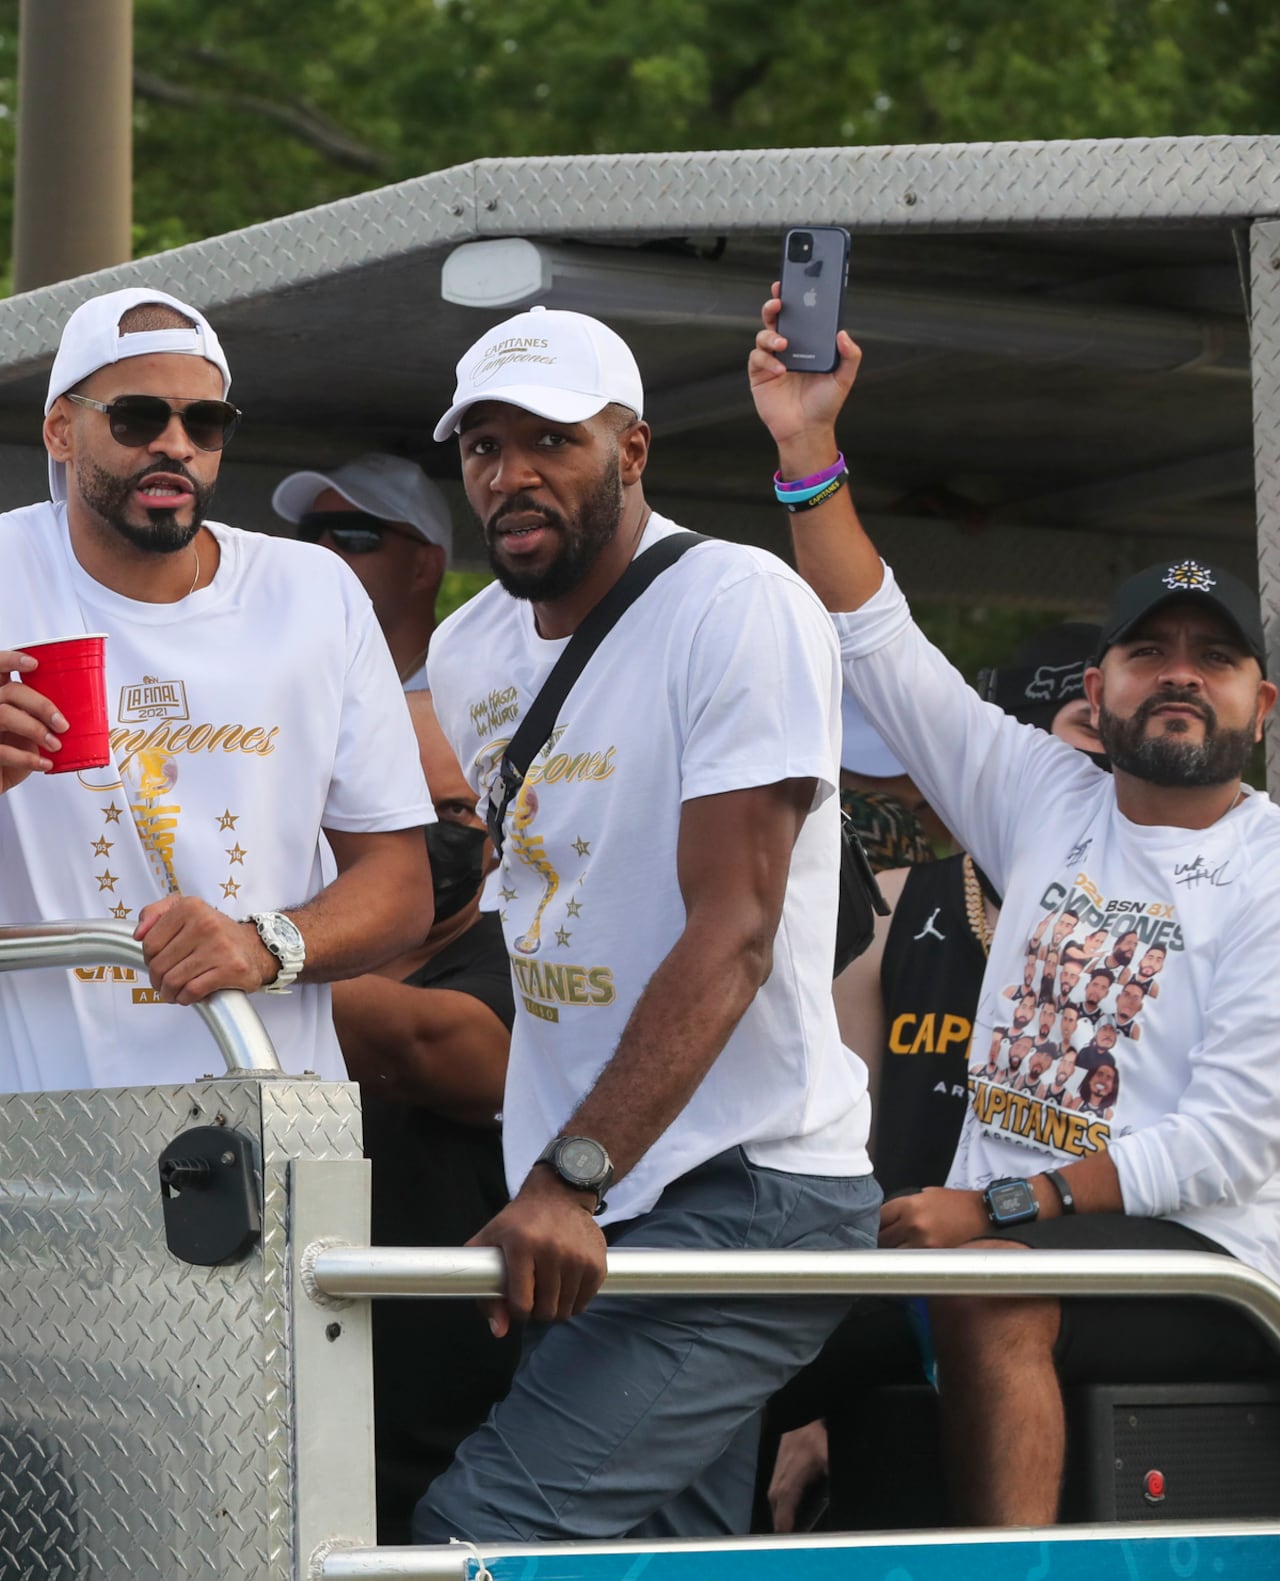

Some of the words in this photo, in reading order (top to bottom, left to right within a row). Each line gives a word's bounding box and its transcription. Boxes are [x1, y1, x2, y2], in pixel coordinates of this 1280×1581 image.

[484, 337, 549, 357] CAPITANES
[470, 353, 557, 387] Campeones
[127, 688, 141, 711] LA
[144, 684, 179, 706] FINAL
[138, 707, 168, 718] 2021
[1105, 900, 1146, 914] BSN
[1146, 903, 1175, 918] 8X
